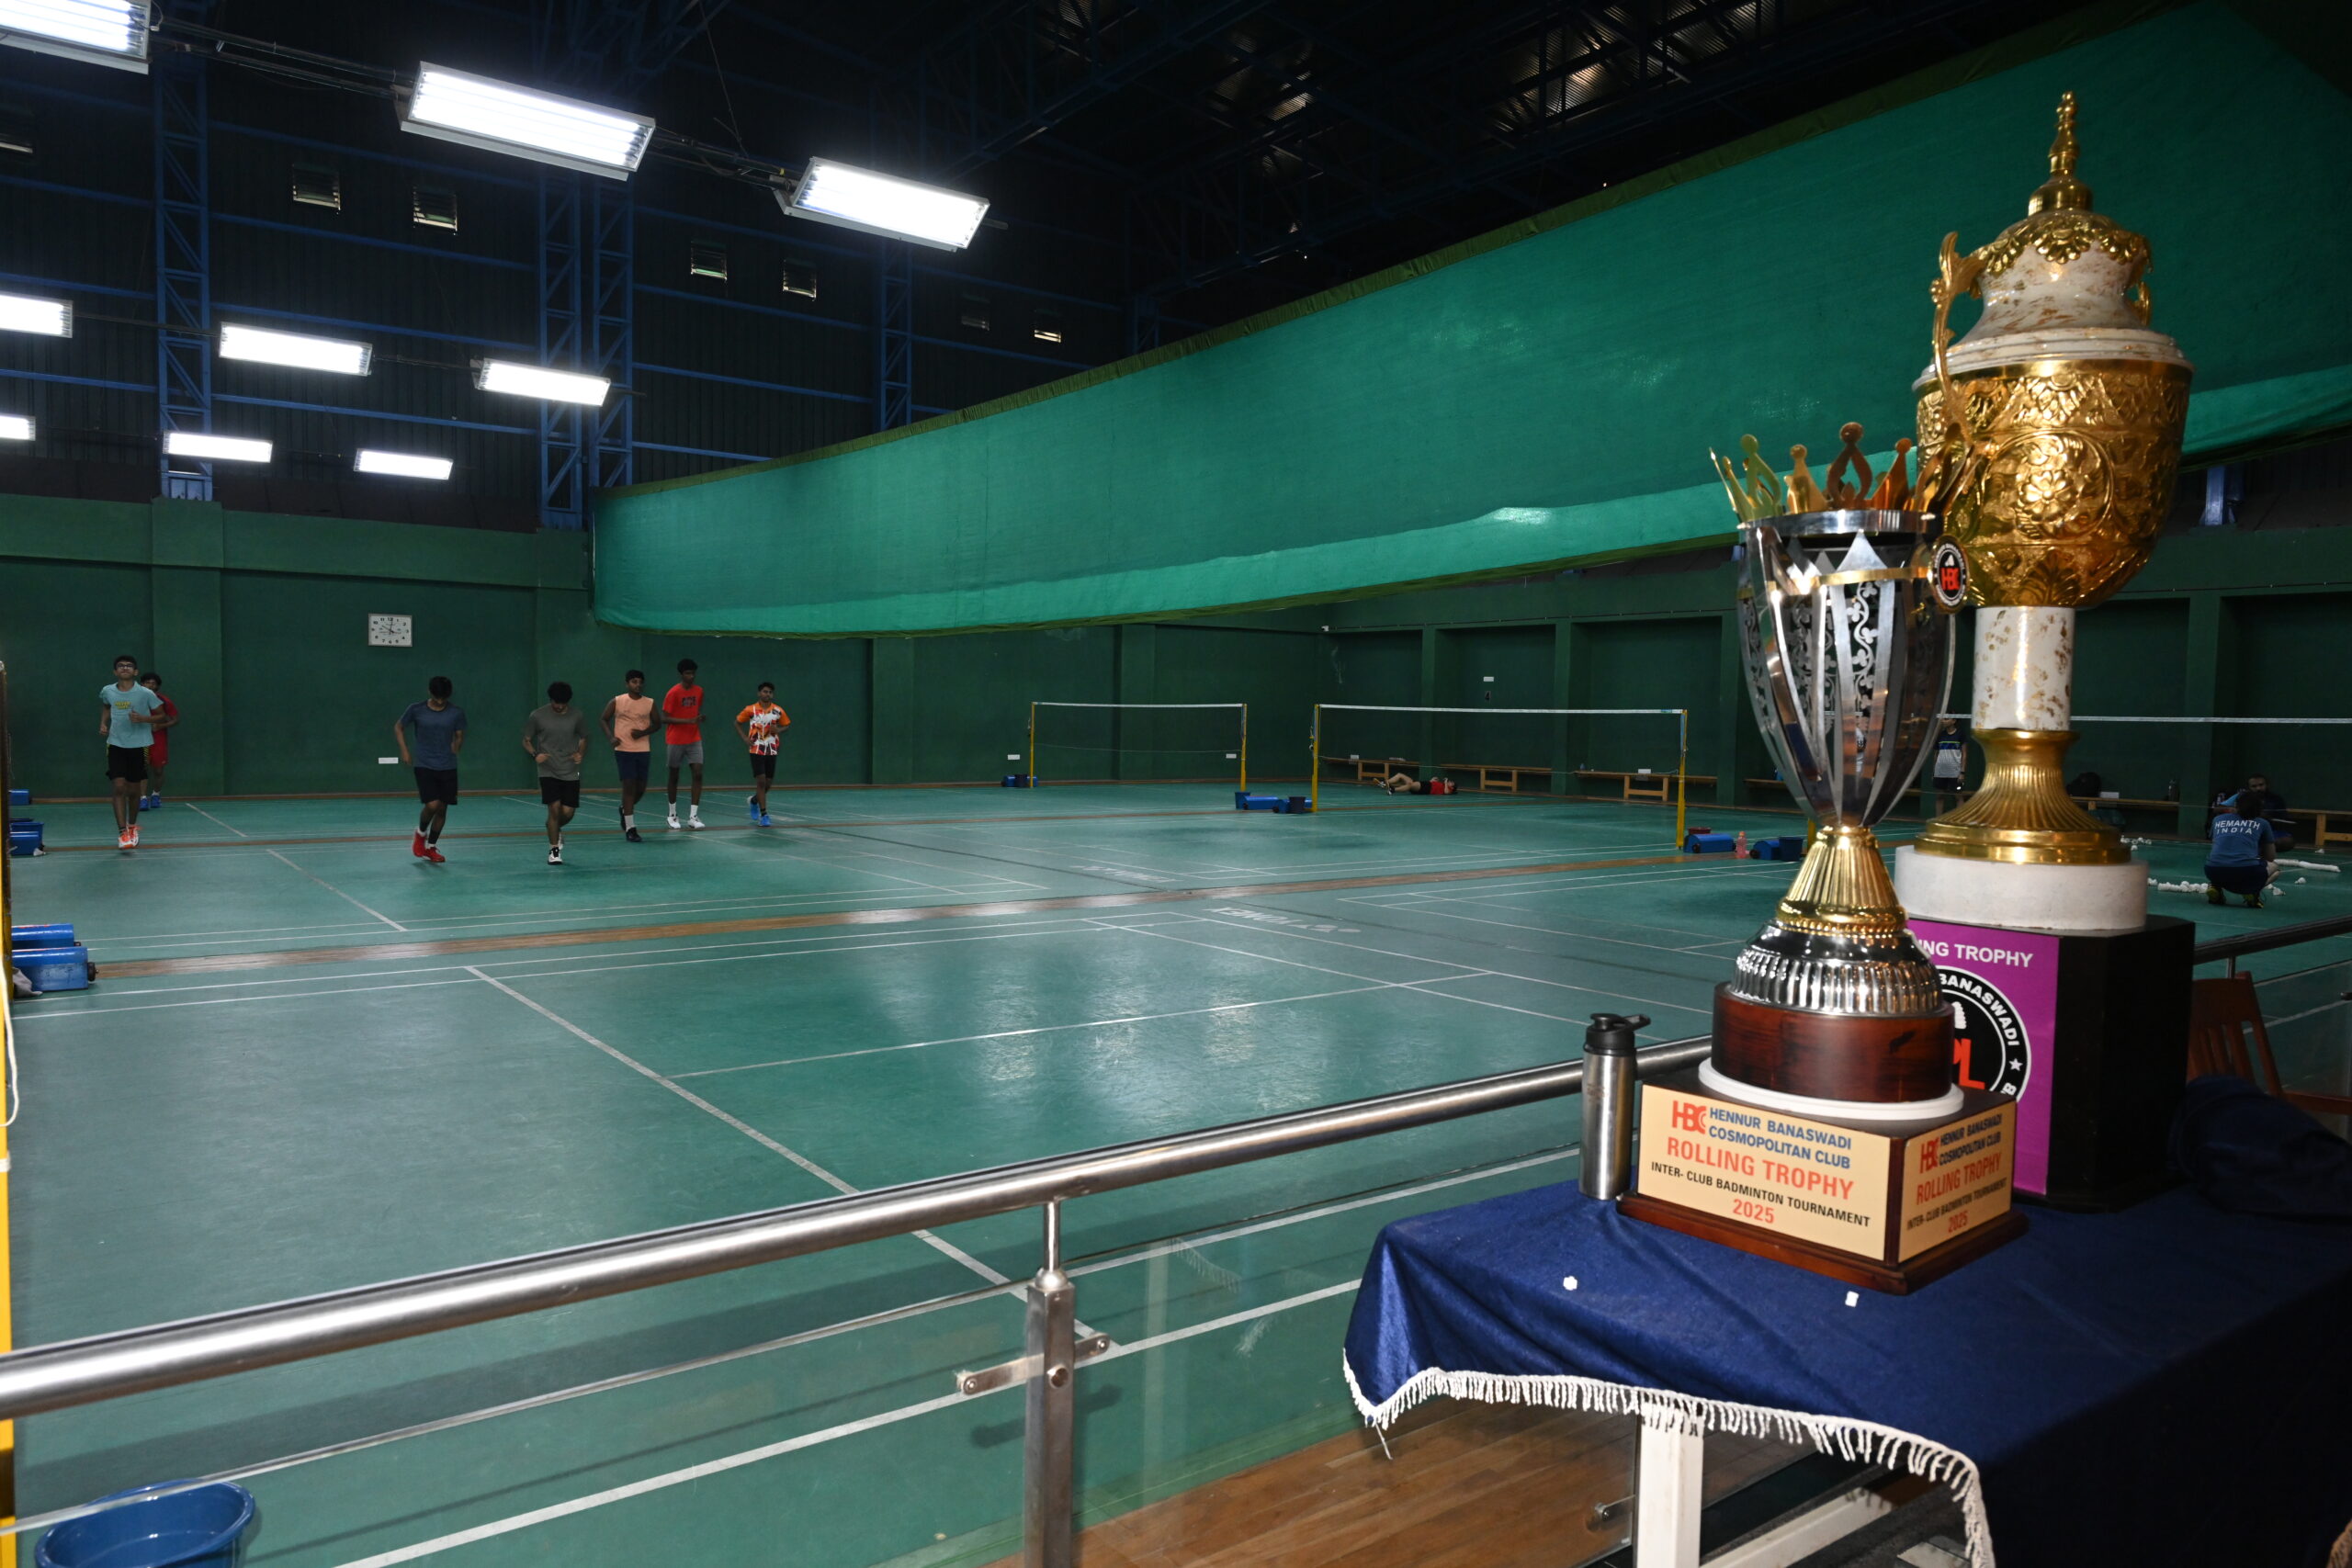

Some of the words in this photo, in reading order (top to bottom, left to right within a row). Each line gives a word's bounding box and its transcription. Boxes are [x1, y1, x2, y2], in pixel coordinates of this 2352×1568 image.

[2214, 819, 2260, 830] HEMANTH
[2216, 827, 2253, 835] INDIA
[1954, 943, 2034, 968] TROPHY
[1710, 1107, 1761, 1129] HENNUR
[1767, 1120, 1851, 1150] BANASWADI
[1940, 1127, 1965, 1146] HENNUR
[1967, 1113, 2003, 1136] BANASWADI
[1709, 1125, 1811, 1160] COSMOPOLITAN
[1815, 1150, 1850, 1169] CLUB
[1939, 1138, 1985, 1166] COSMOPOLITAN
[1986, 1131, 2002, 1148] CLUB
[1668, 1136, 1755, 1177] ROLLING
[1761, 1159, 1854, 1201] TROPHY
[1917, 1168, 1961, 1205] ROLLING
[1963, 1152, 2002, 1185] TROPHY
[1651, 1161, 1683, 1178] INTER-
[1687, 1170, 1713, 1186] CLUB
[1716, 1179, 1784, 1205] BADMINTON
[1787, 1197, 1871, 1227] TOURNAMENT
[1733, 1199, 1775, 1224] 2025
[1948, 1210, 1969, 1234] 2025
